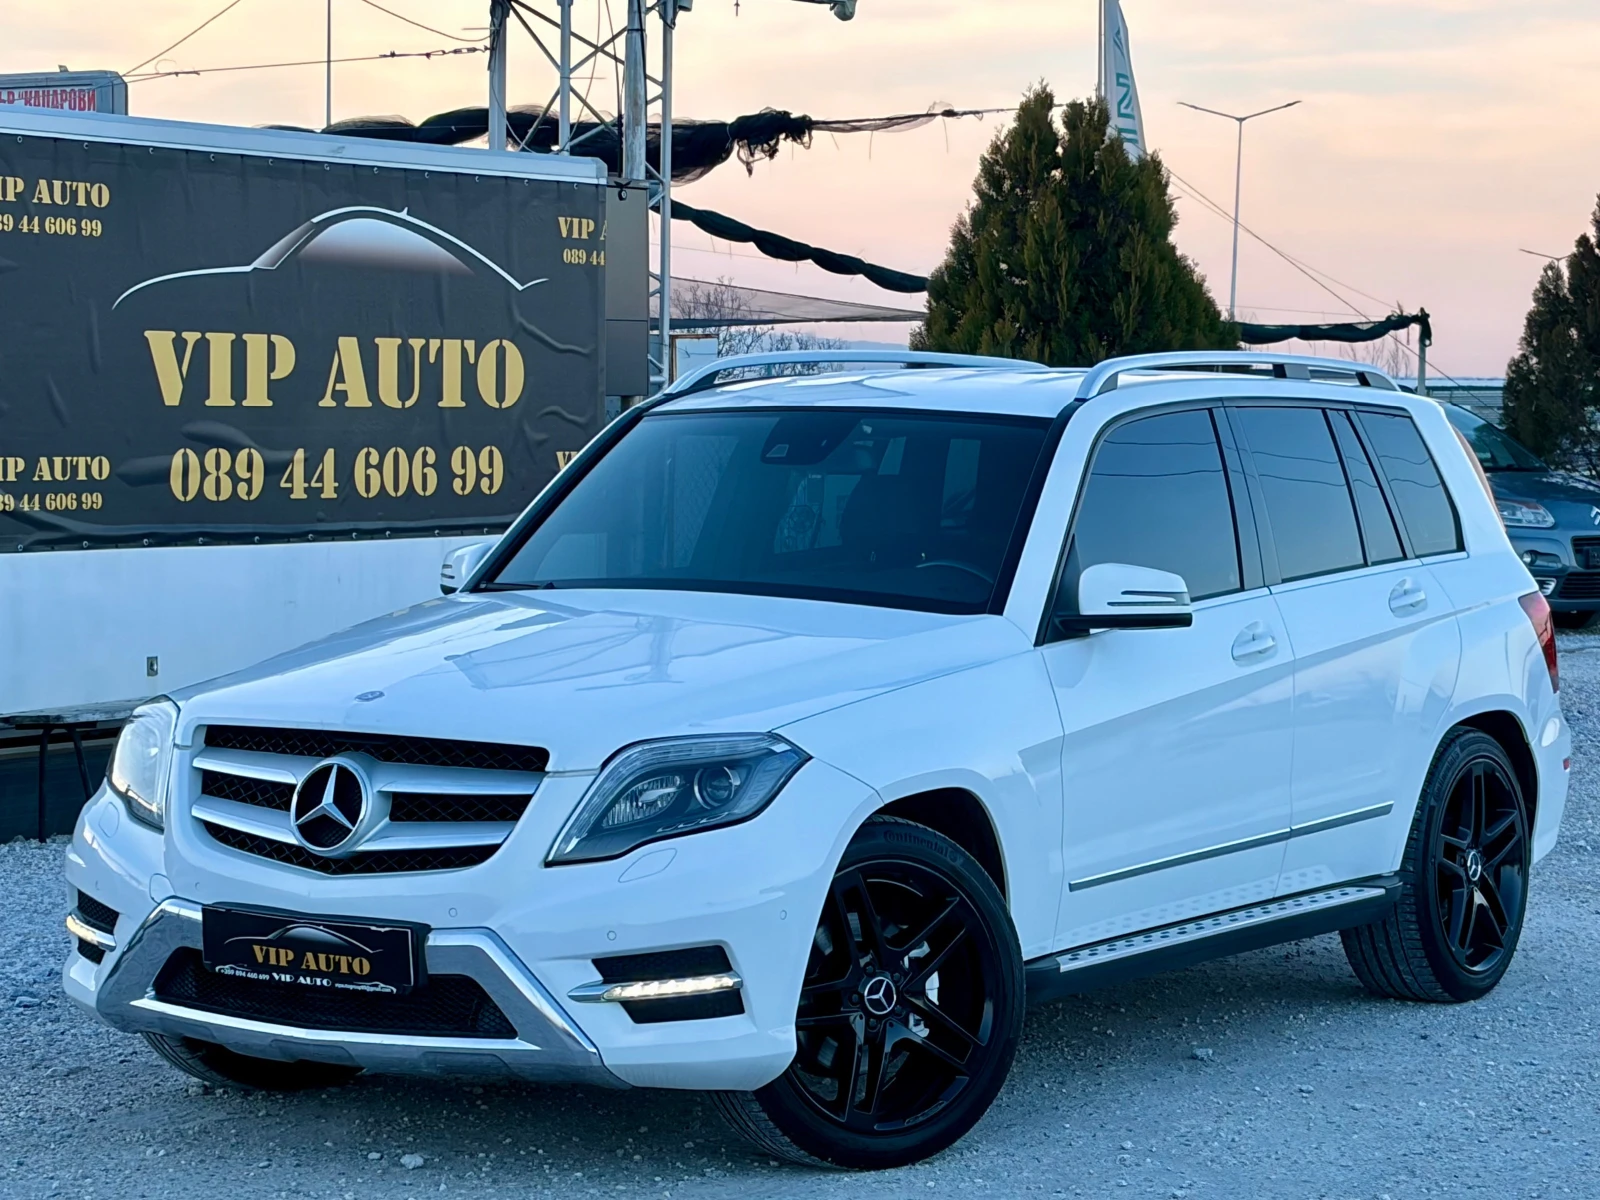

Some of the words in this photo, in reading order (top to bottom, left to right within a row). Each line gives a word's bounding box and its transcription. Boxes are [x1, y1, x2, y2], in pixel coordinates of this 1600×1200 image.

[32, 179, 110, 208] AUTO
[18, 215, 40, 234] 44
[45, 216, 77, 236] 606
[81, 218, 102, 237] 99
[557, 216, 595, 240] VIP
[563, 248, 587, 265] 089
[589, 250, 606, 266] 44
[144, 330, 296, 407] VIP
[318, 336, 525, 409] AUTO
[32, 456, 110, 481] AUTO
[169, 447, 265, 502] 089
[280, 447, 339, 499] 44
[353, 446, 437, 498] 606
[451, 445, 504, 496] 99
[19, 493, 40, 512] 44
[45, 492, 78, 511] 606
[81, 492, 103, 510] 99
[252, 944, 294, 967] VIP
[301, 951, 371, 975] AUTO
[271, 972, 295, 982] VIP
[297, 975, 332, 987] AUTO
